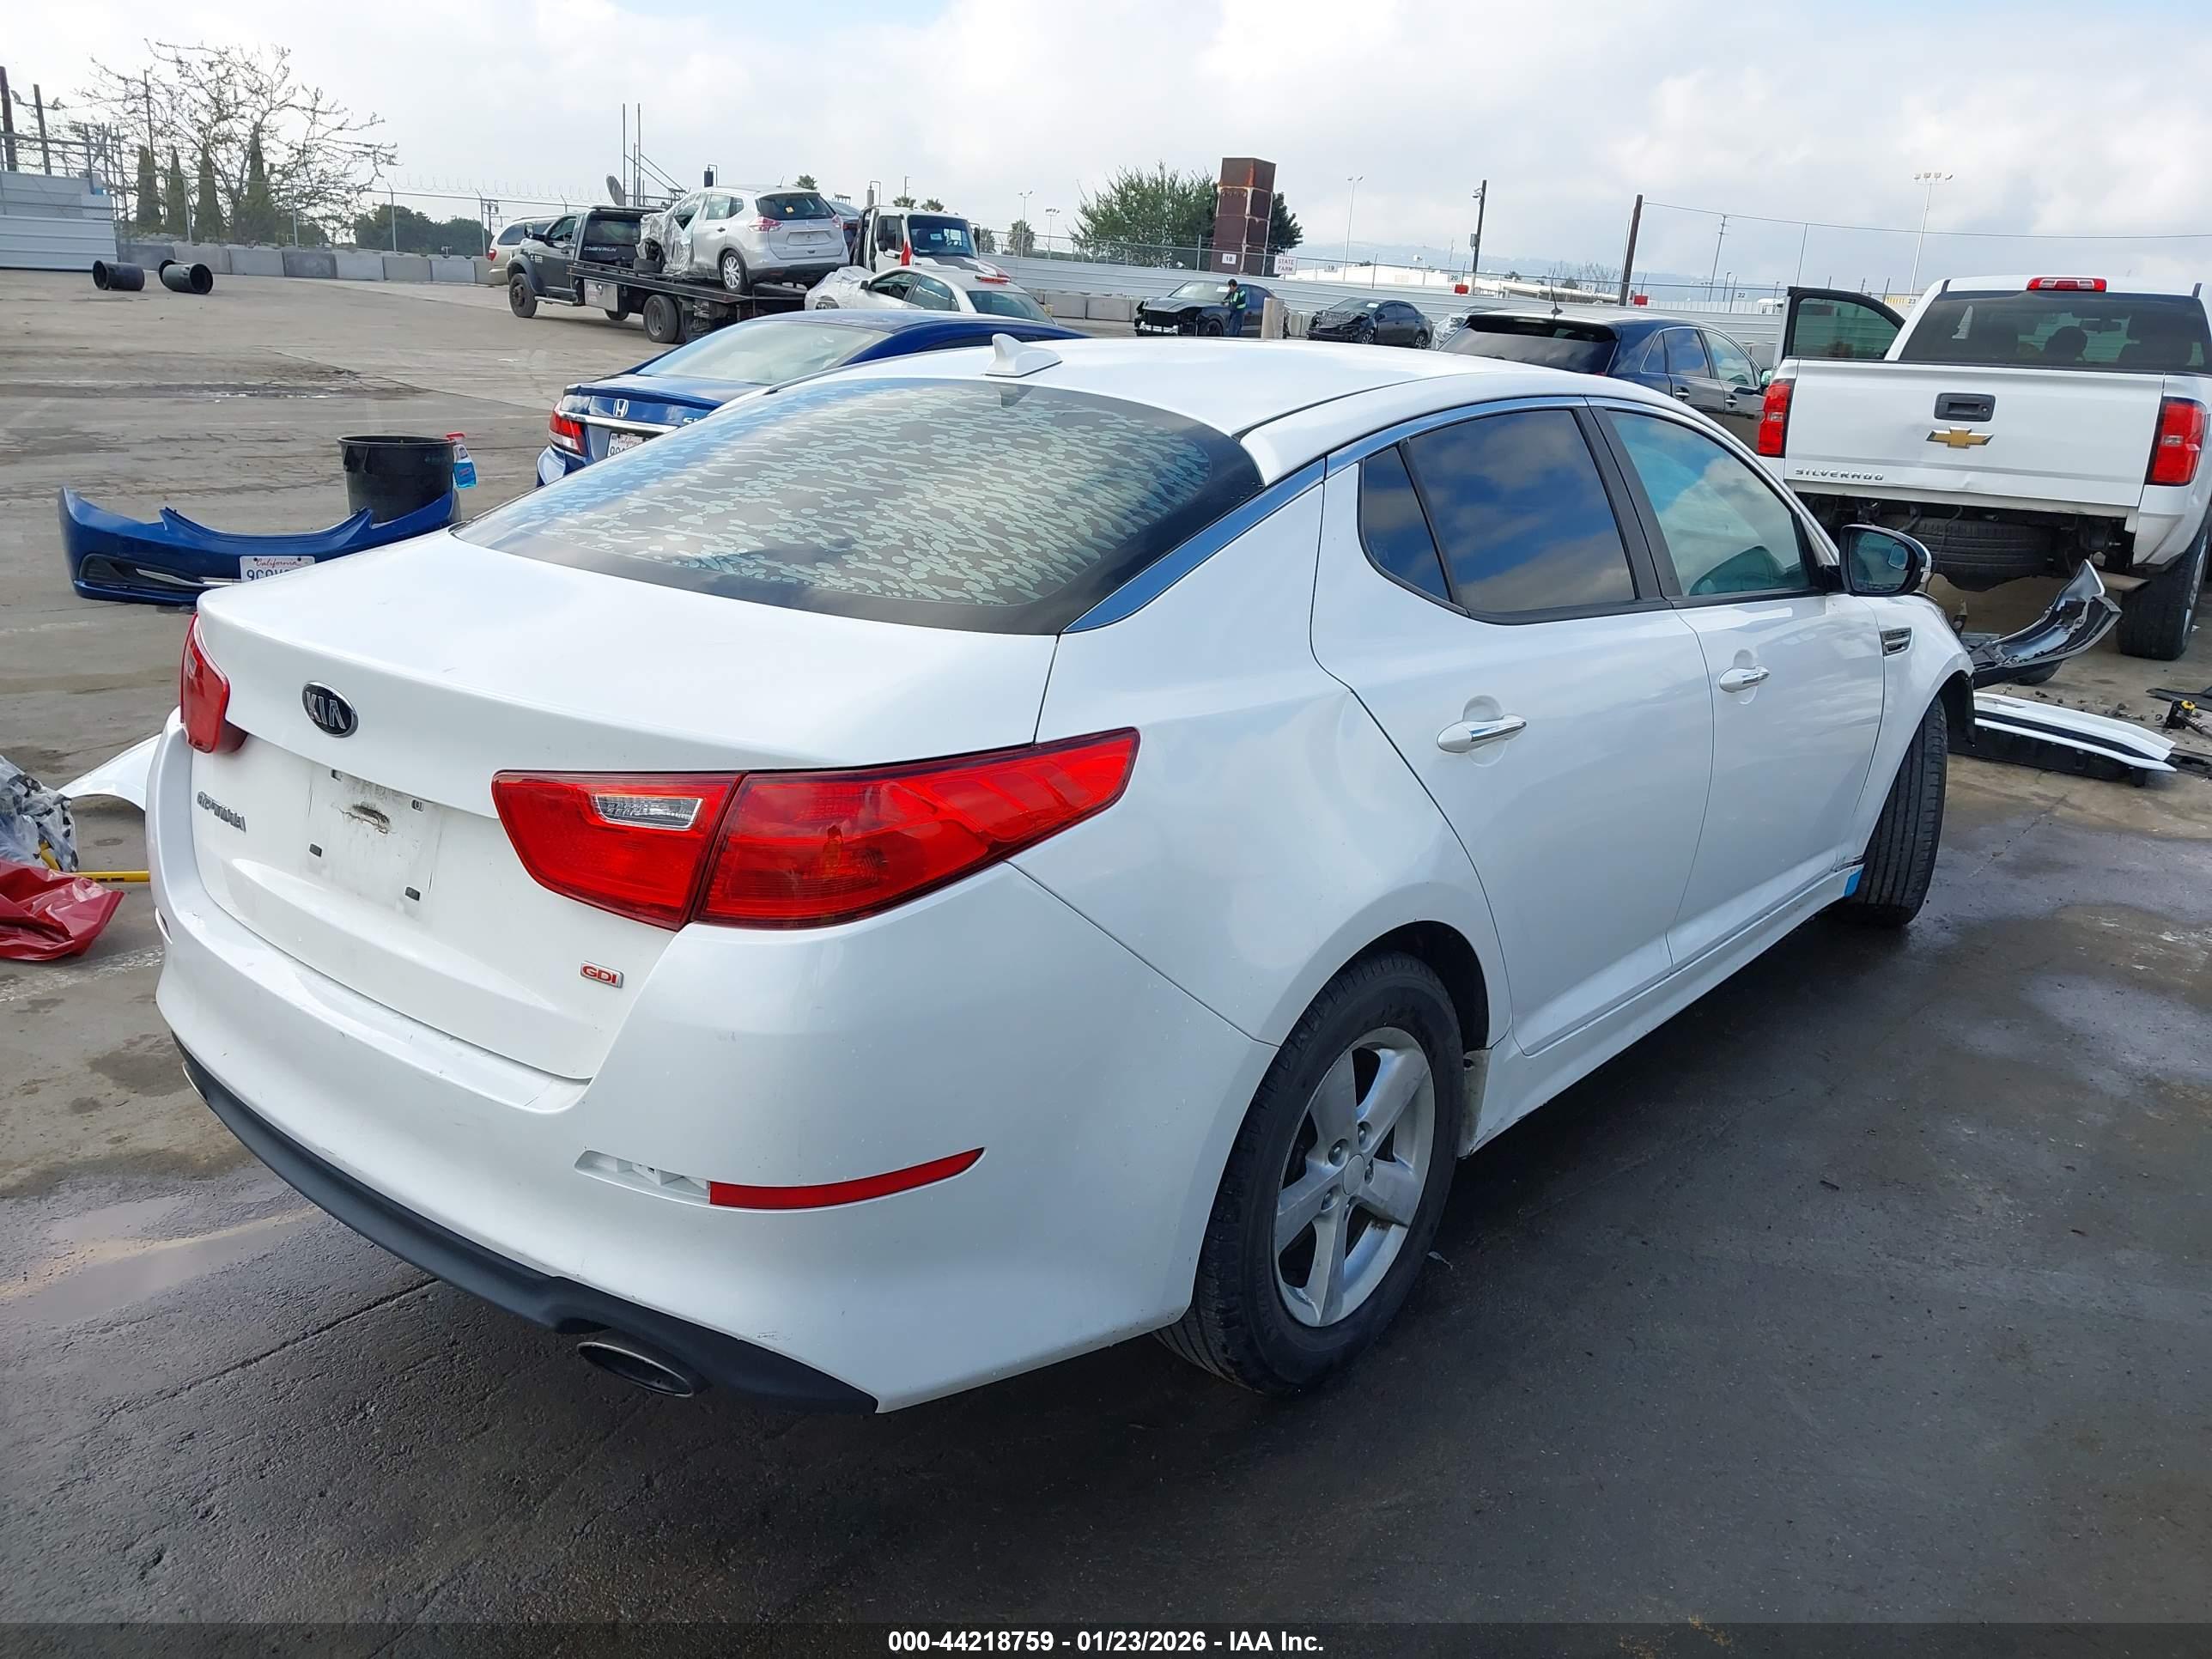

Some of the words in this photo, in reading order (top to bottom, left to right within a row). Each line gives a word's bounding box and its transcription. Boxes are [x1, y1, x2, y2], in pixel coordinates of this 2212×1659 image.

[1796, 468, 1884, 481] SILVERADO
[256, 558, 301, 568] California
[306, 691, 347, 729] KIA
[583, 966, 617, 984] GDI
